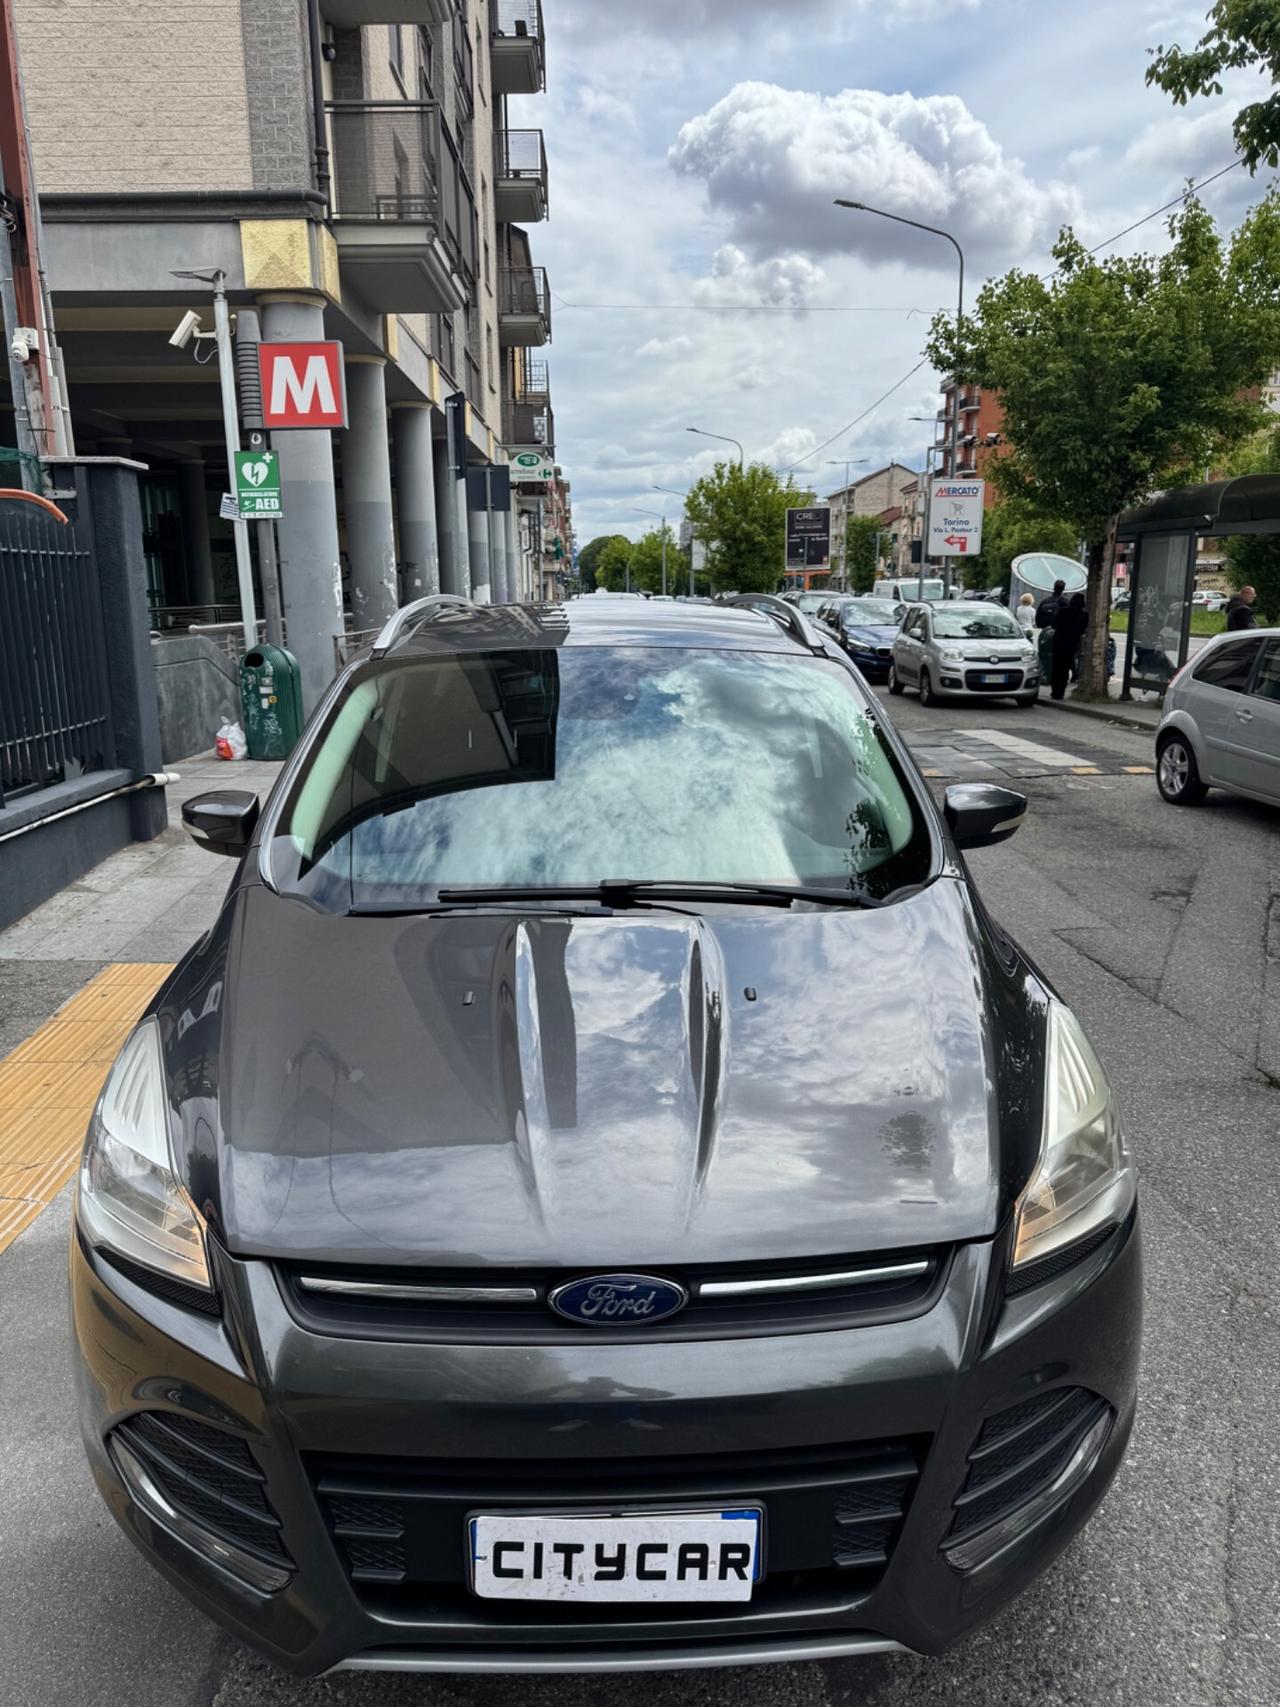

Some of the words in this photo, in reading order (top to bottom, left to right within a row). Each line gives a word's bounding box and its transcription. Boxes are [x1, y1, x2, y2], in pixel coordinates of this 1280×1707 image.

[270, 356, 337, 414] M
[935, 487, 979, 497] MERCATO
[255, 498, 279, 510] AED
[944, 518, 970, 526] Torino
[580, 1283, 656, 1316] Ford
[492, 1541, 751, 1581] CITYCAR
